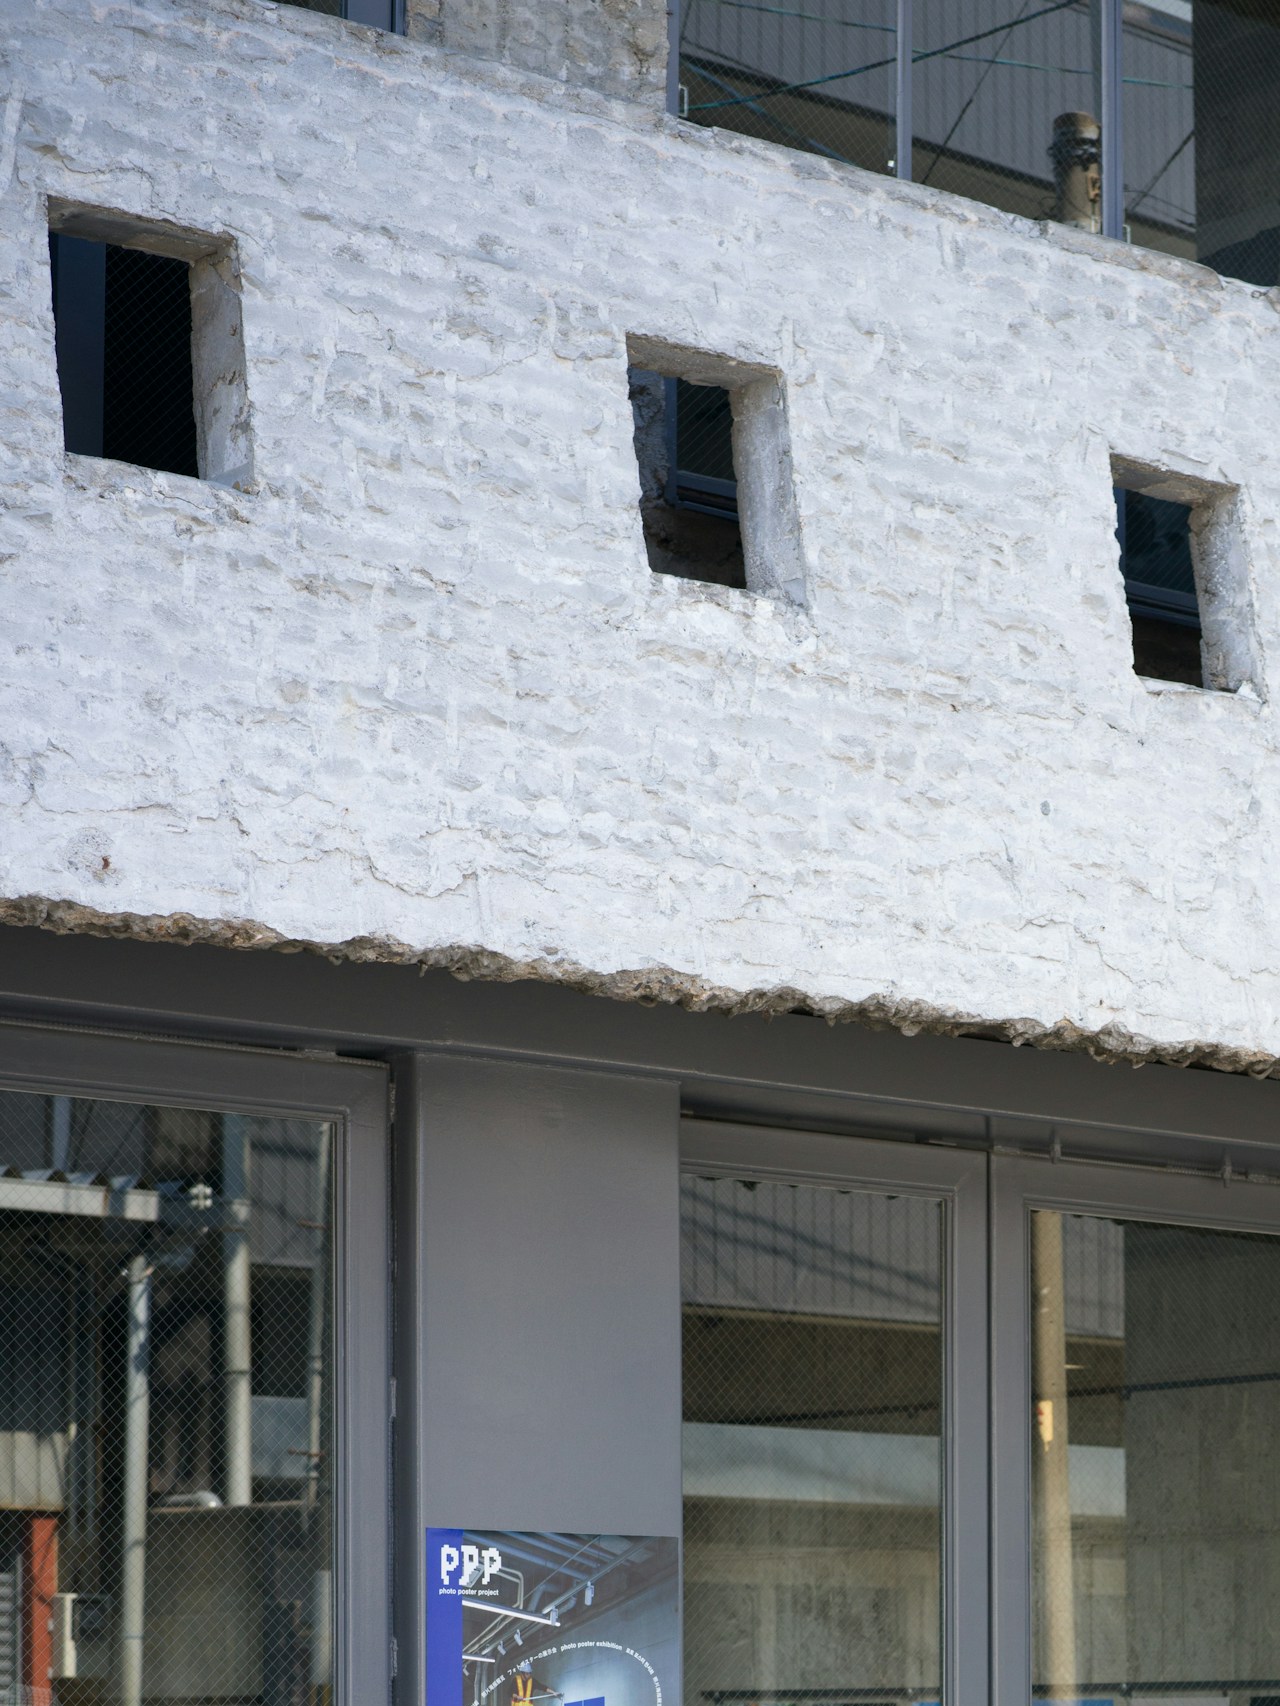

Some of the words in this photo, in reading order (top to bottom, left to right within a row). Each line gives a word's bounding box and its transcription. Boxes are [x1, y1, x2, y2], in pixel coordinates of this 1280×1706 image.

[458, 1588, 477, 1596] poster
[478, 1589, 499, 1597] project
[560, 1642, 577, 1652] photo
[577, 1640, 595, 1648] poster
[596, 1641, 622, 1651] exhibition
